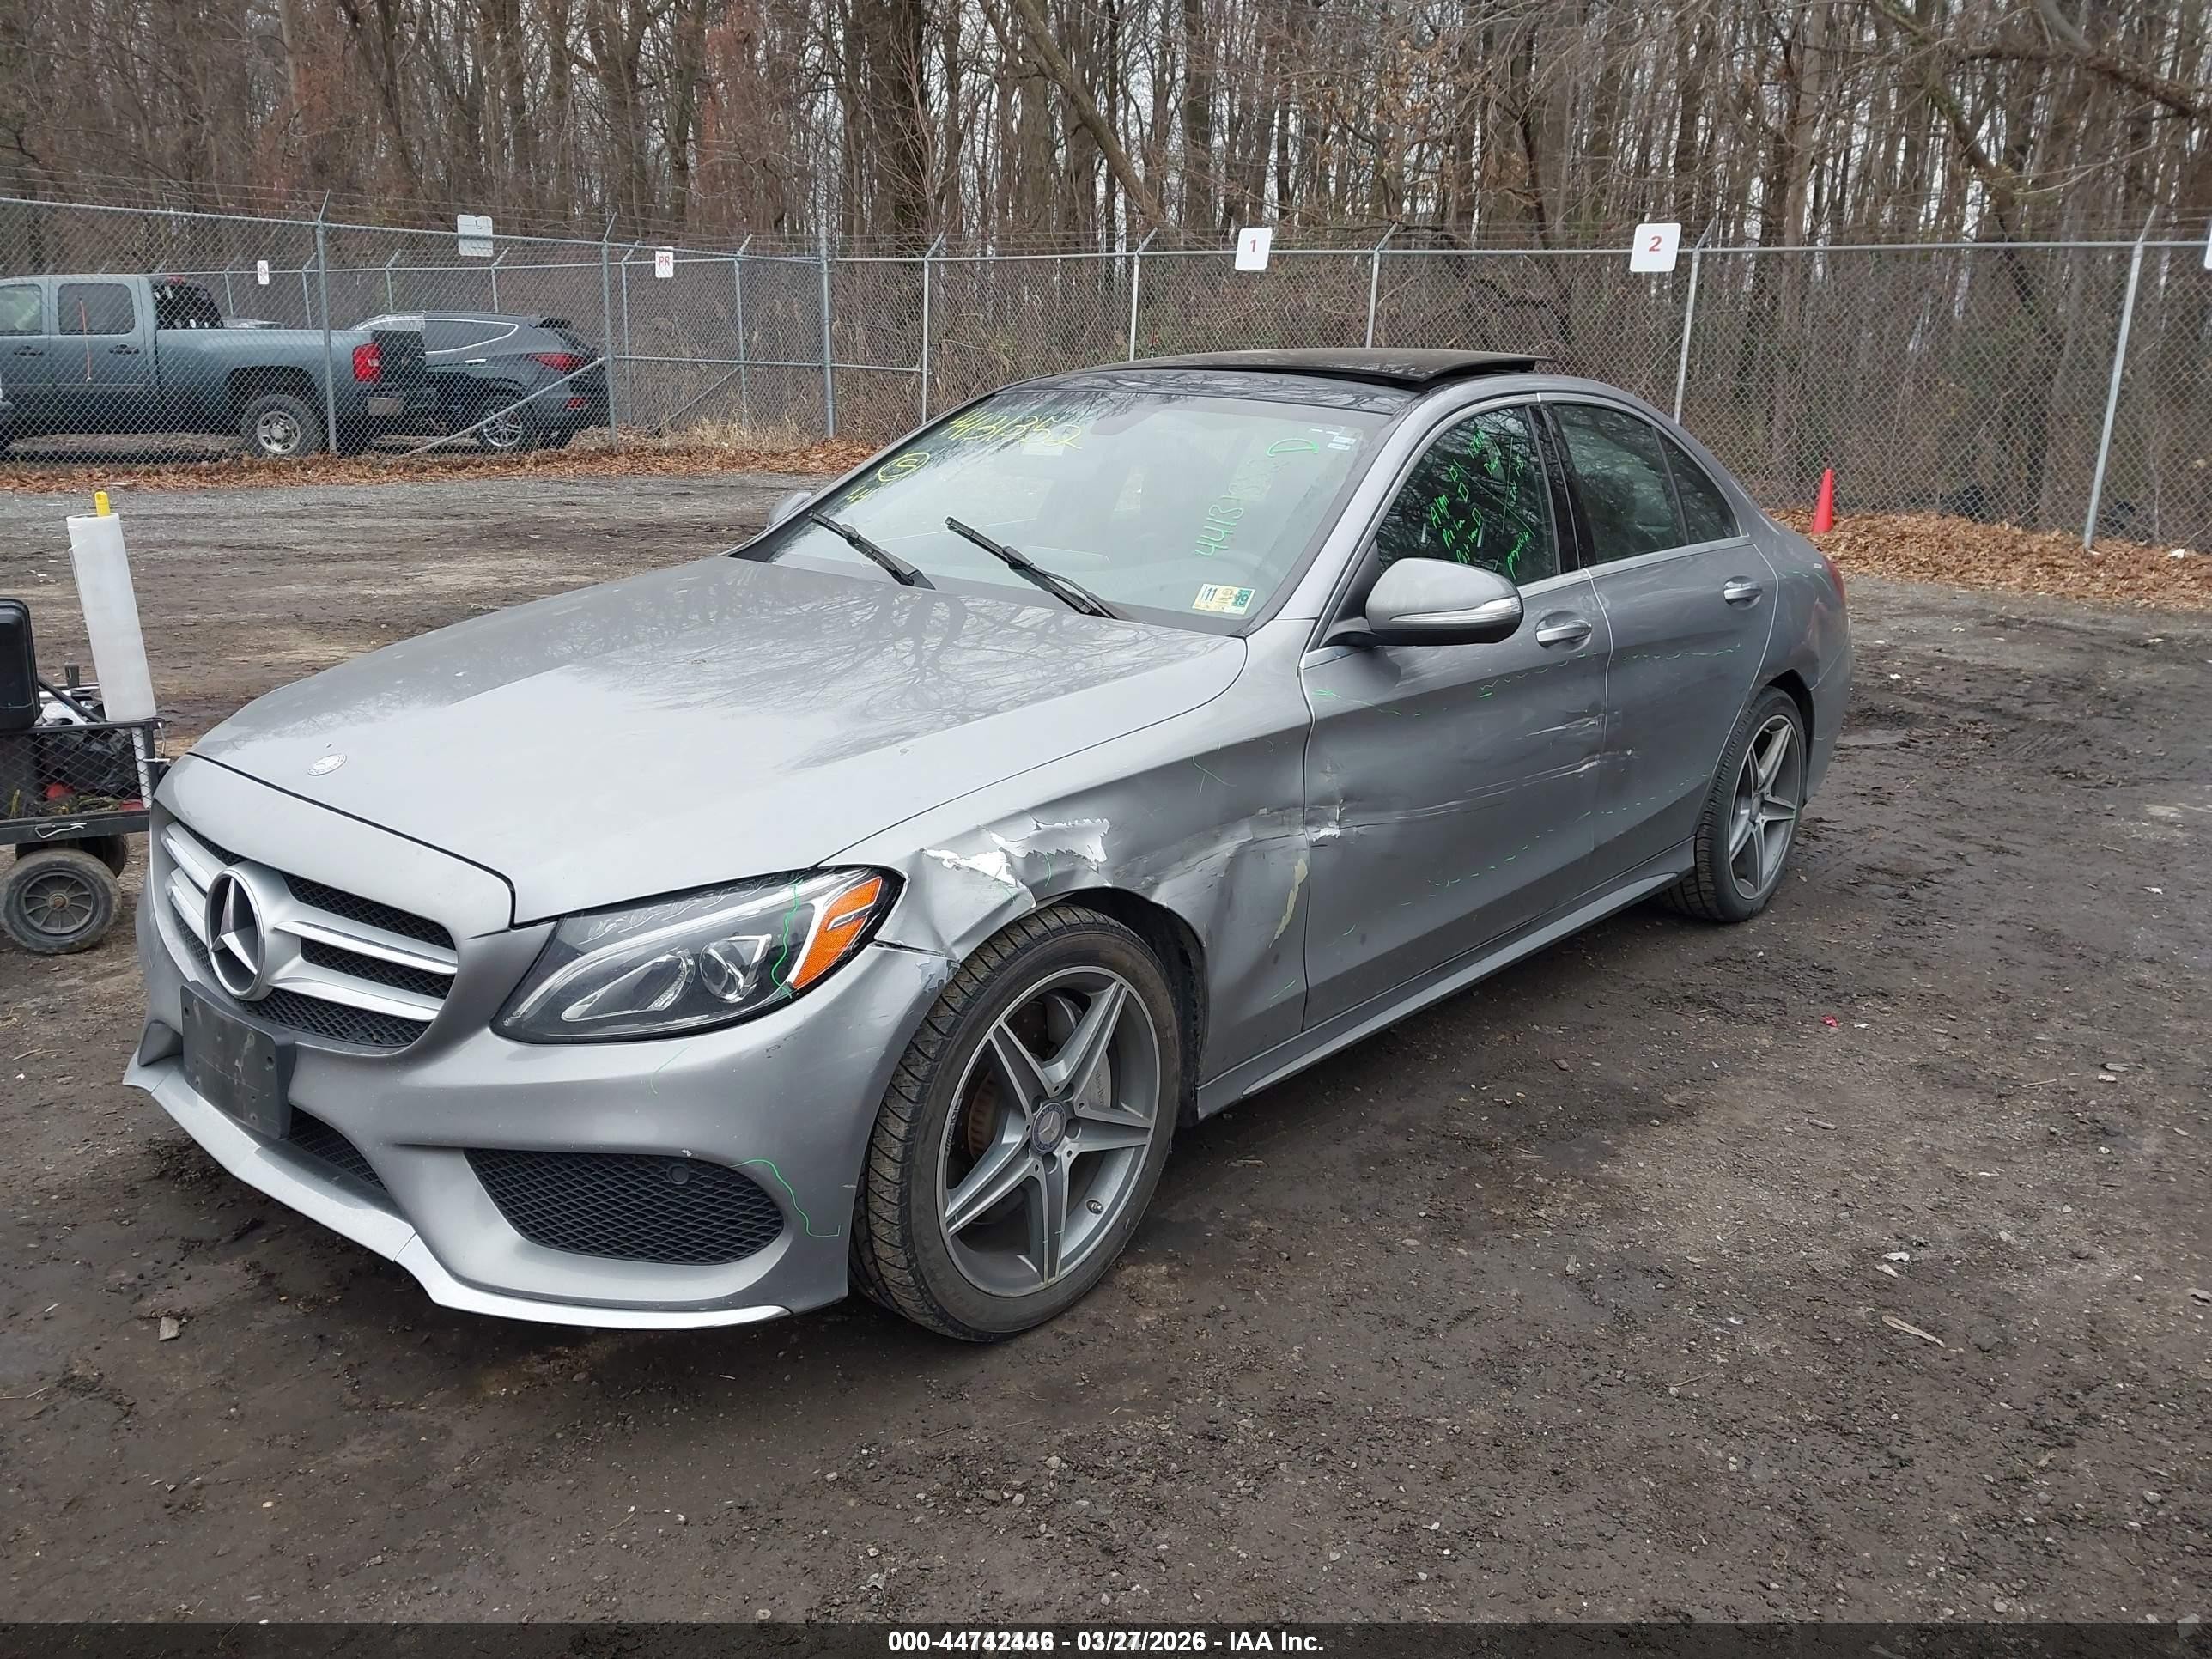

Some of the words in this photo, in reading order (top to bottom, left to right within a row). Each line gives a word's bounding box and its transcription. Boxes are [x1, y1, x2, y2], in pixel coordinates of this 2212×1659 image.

[1249, 238, 1256, 253] 1
[1648, 235, 1662, 252] 2
[659, 255, 670, 267] PR
